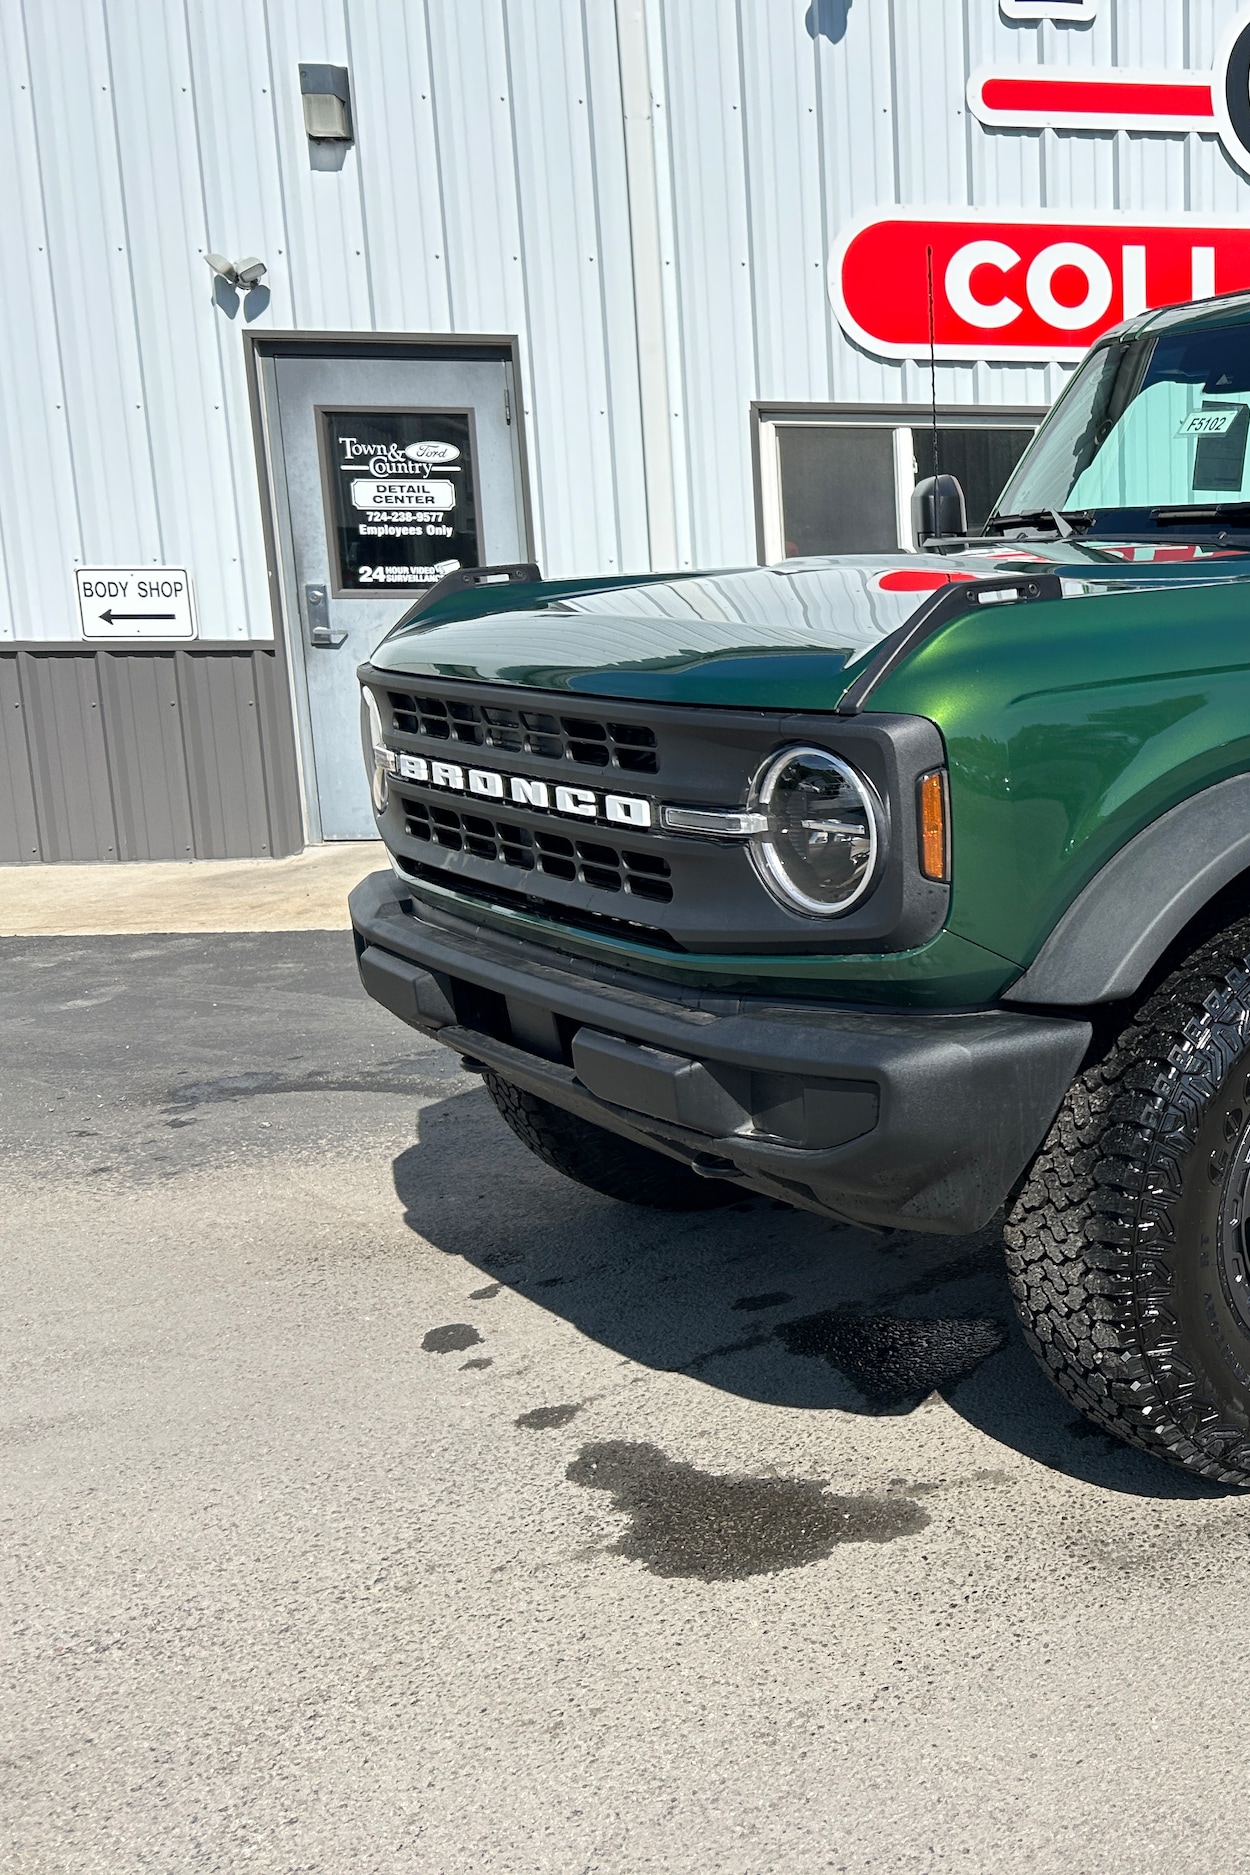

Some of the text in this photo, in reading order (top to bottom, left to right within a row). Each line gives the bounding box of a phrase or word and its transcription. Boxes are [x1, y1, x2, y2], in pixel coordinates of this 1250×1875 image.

[1186, 417, 1227, 432] F5102
[338, 437, 448, 462] Town & Ford
[369, 456, 433, 479] Country
[376, 485, 431, 494] DETAIL
[372, 495, 435, 504] CENTER
[366, 511, 444, 522] 724-238-9577
[359, 524, 453, 538] Employees Only
[358, 565, 435, 583] 24 HOUR VIDEO
[82, 581, 183, 598] BODY SHOP
[400, 753, 652, 828] BRONCO
